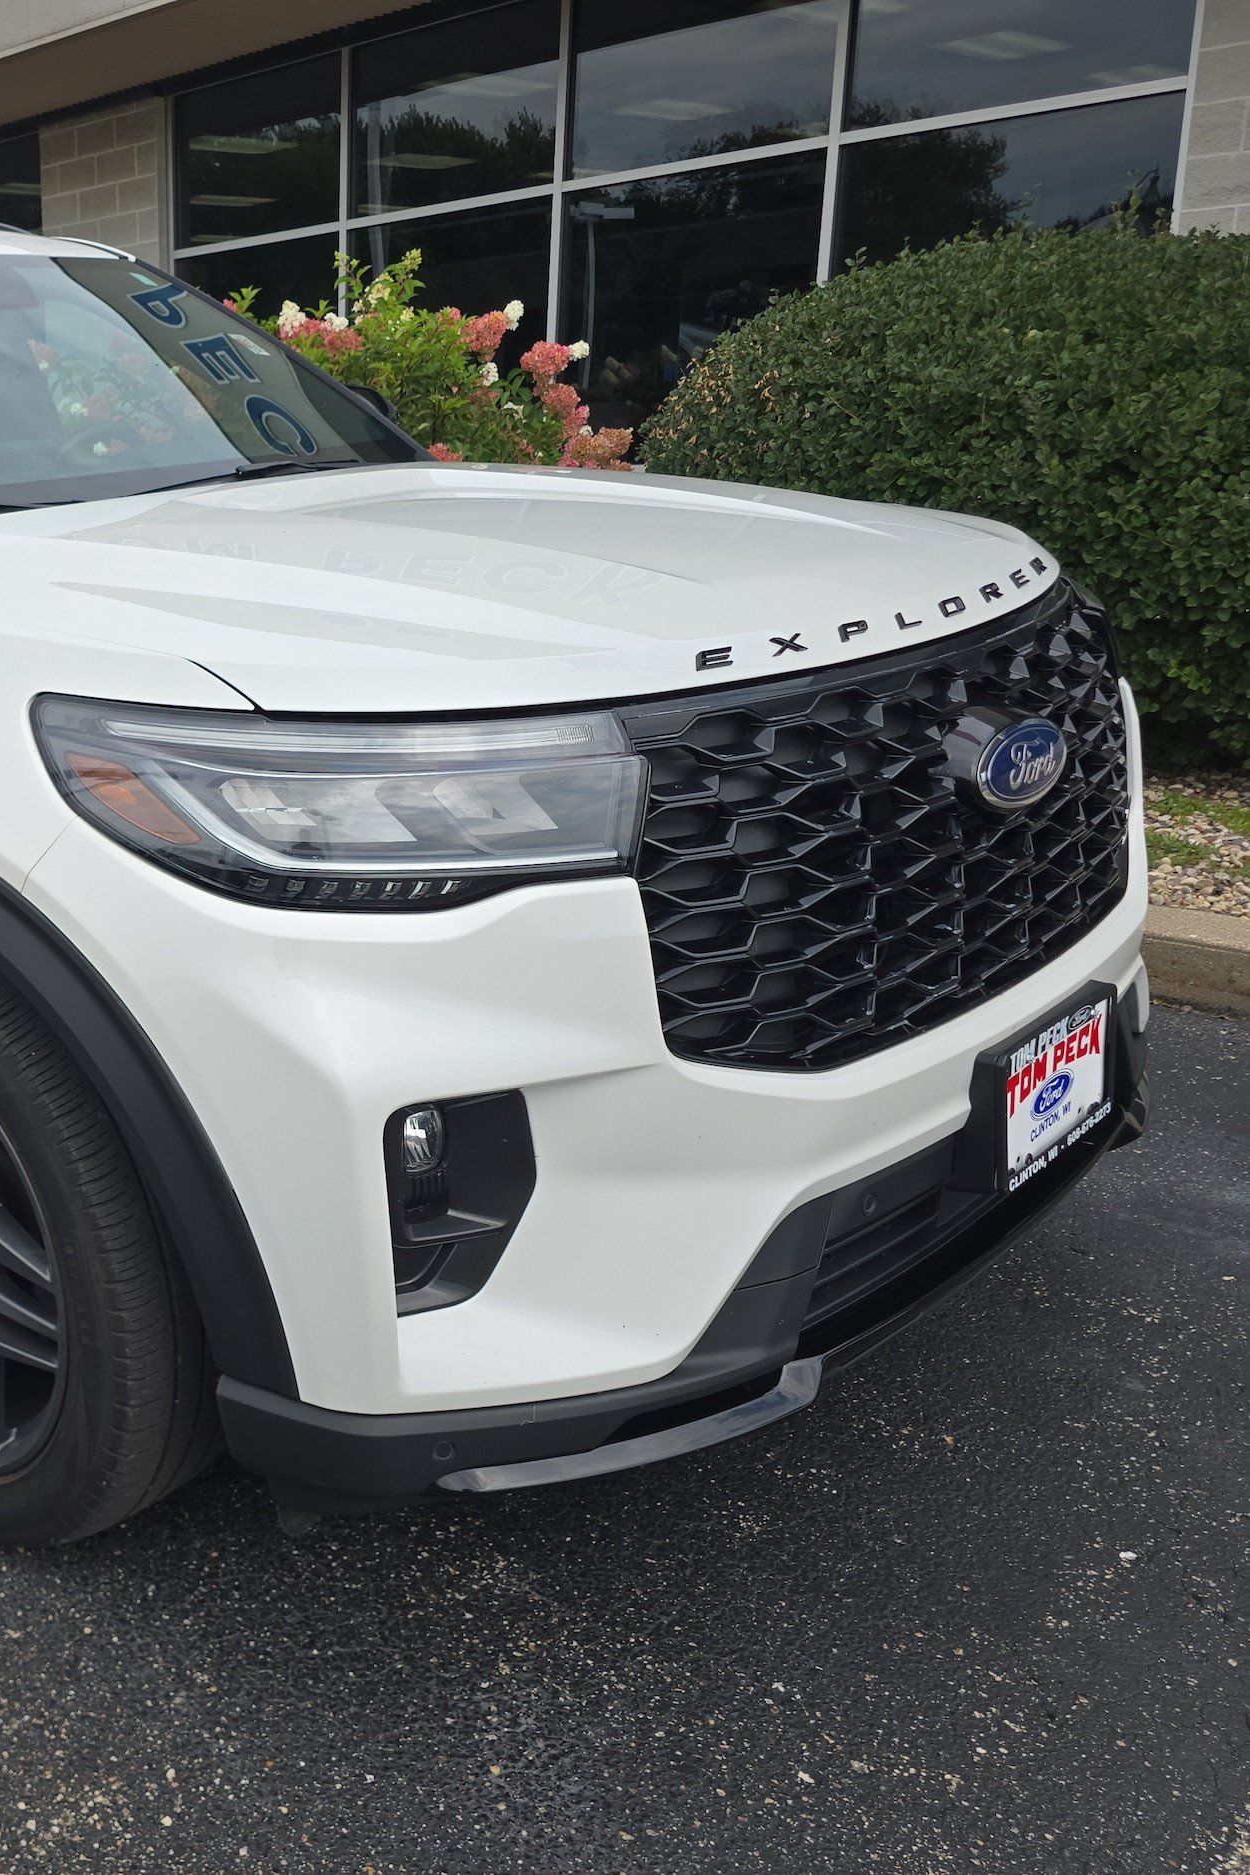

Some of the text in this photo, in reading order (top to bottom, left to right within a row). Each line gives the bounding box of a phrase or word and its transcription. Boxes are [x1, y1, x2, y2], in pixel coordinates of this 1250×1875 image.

[695, 556, 1048, 672] EXPLORER
[1009, 736, 1056, 791] Ford
[1006, 1013, 1101, 1120] TOM PECK
[1010, 1015, 1070, 1077] TOM PECK
[1030, 1101, 1071, 1142] CLINTON, WI
[1039, 1078, 1065, 1112] Ford
[1009, 1155, 1047, 1192] CLINTON,
[1048, 1145, 1059, 1162] WI
